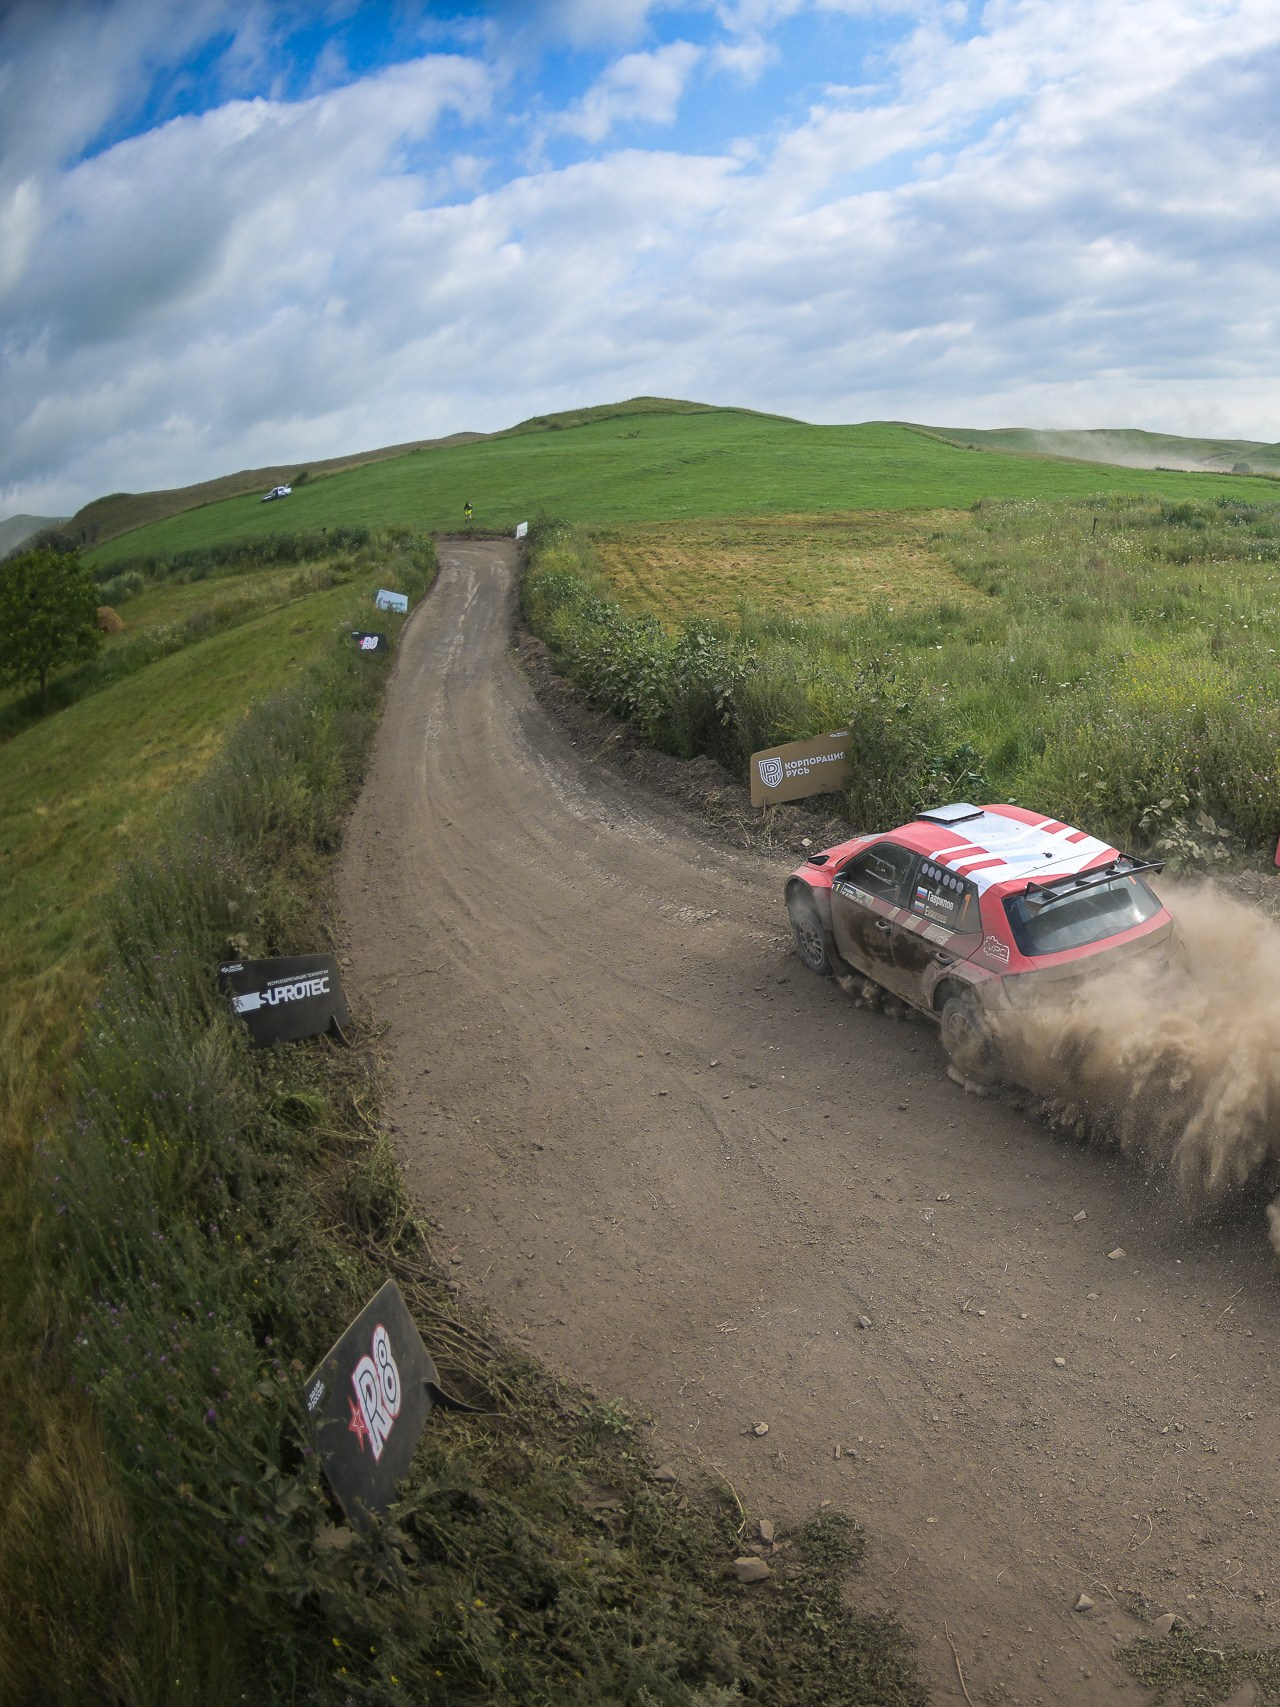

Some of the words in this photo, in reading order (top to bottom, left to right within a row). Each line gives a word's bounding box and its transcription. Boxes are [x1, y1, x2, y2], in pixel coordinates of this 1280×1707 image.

[784, 751, 845, 770] КОРПОРАЦИЯ
[786, 767, 810, 778] РУСЬ
[927, 890, 955, 911] Гаврилов
